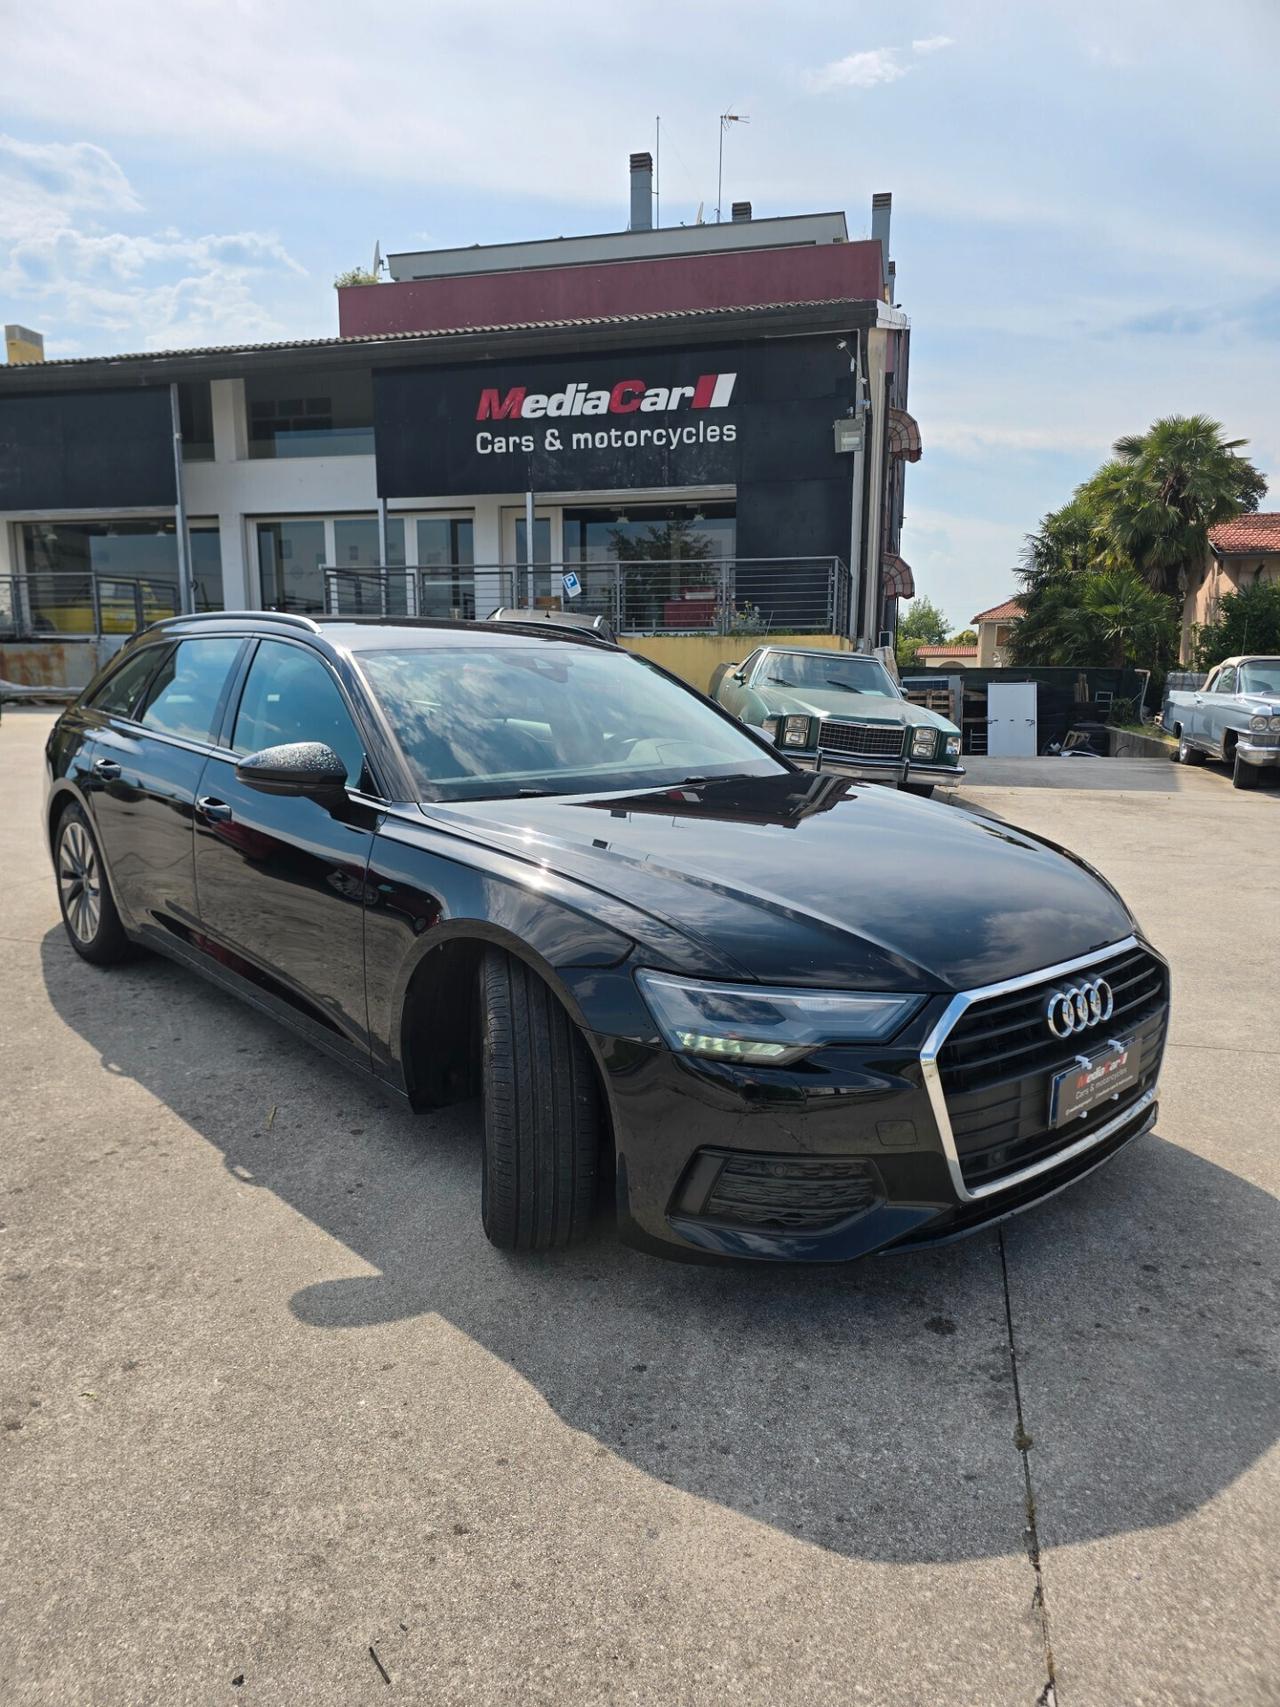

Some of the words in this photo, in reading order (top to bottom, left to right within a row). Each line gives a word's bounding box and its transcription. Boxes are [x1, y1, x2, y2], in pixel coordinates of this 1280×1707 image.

[476, 379, 695, 421] MediaCar
[476, 432, 534, 454] Cars
[544, 428, 563, 450] &
[572, 421, 737, 450] motorcycles
[565, 575, 575, 589] P
